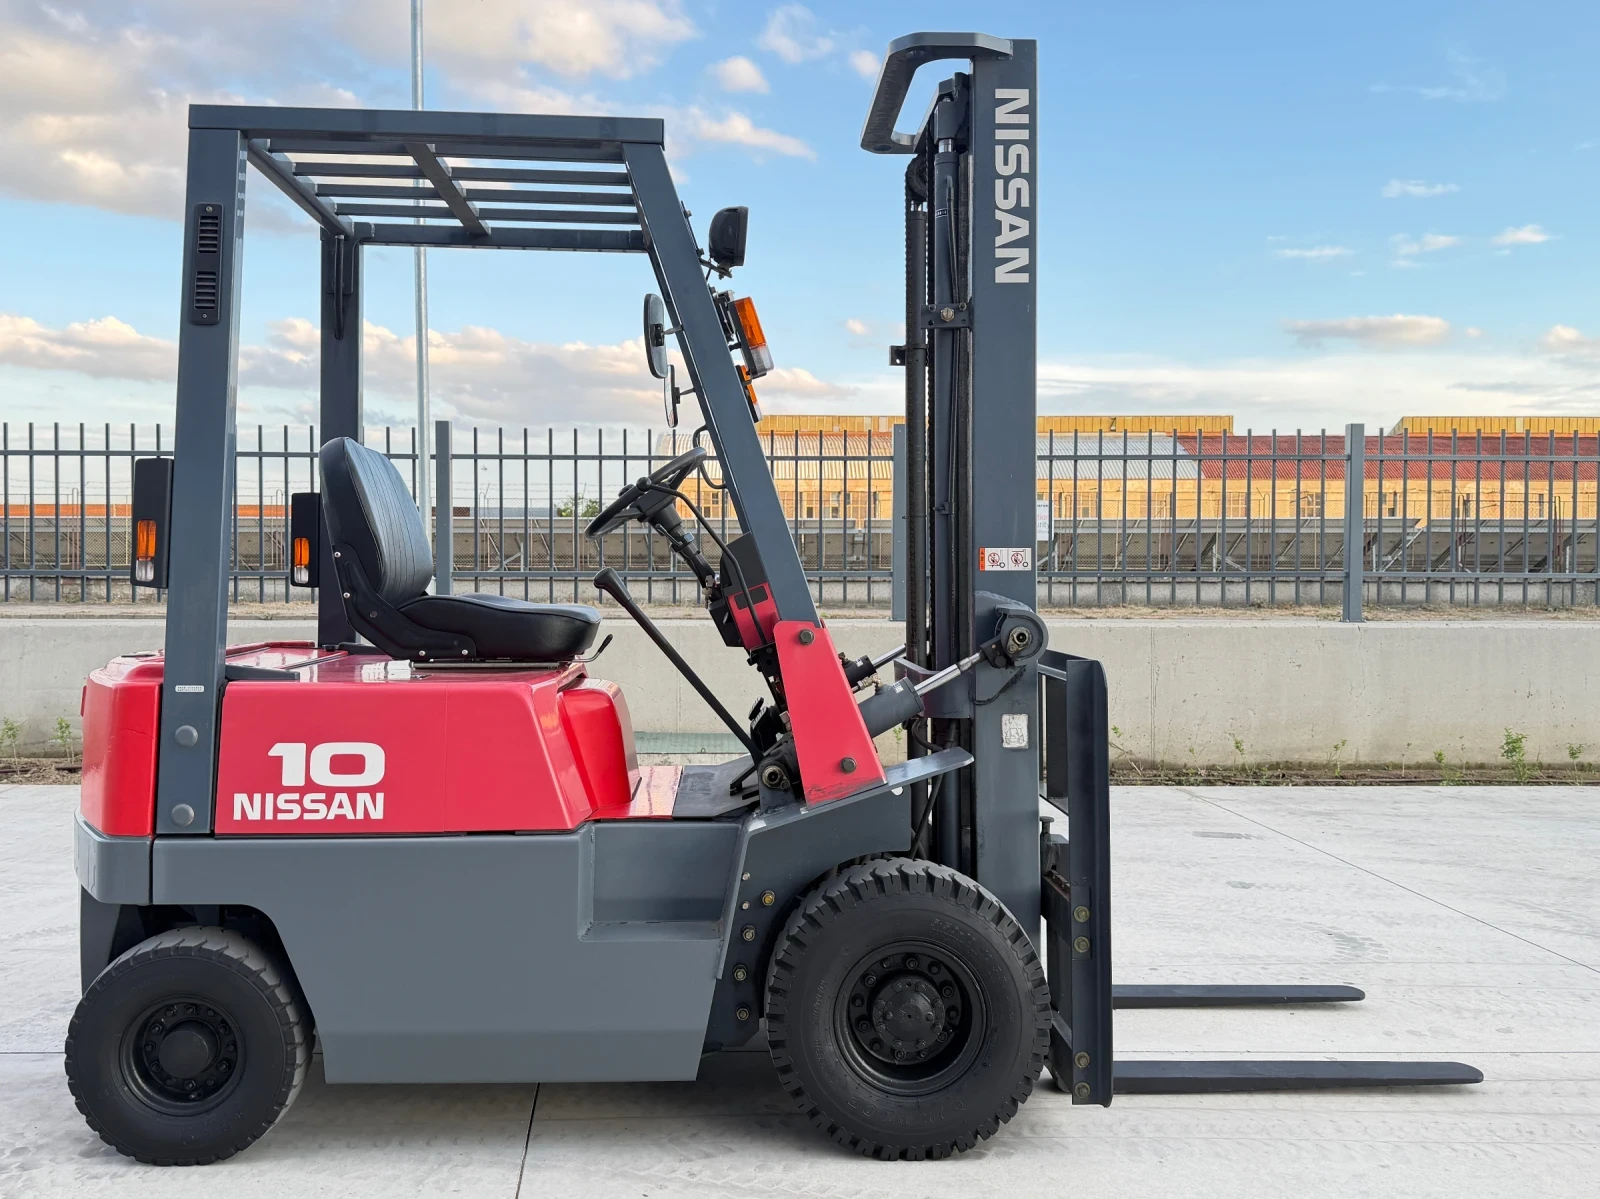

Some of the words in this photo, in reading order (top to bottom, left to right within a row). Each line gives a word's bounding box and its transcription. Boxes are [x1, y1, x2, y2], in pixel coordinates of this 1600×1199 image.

[995, 88, 1030, 284] NISSAN
[267, 741, 386, 787] 10
[233, 792, 385, 821] NISSAN
